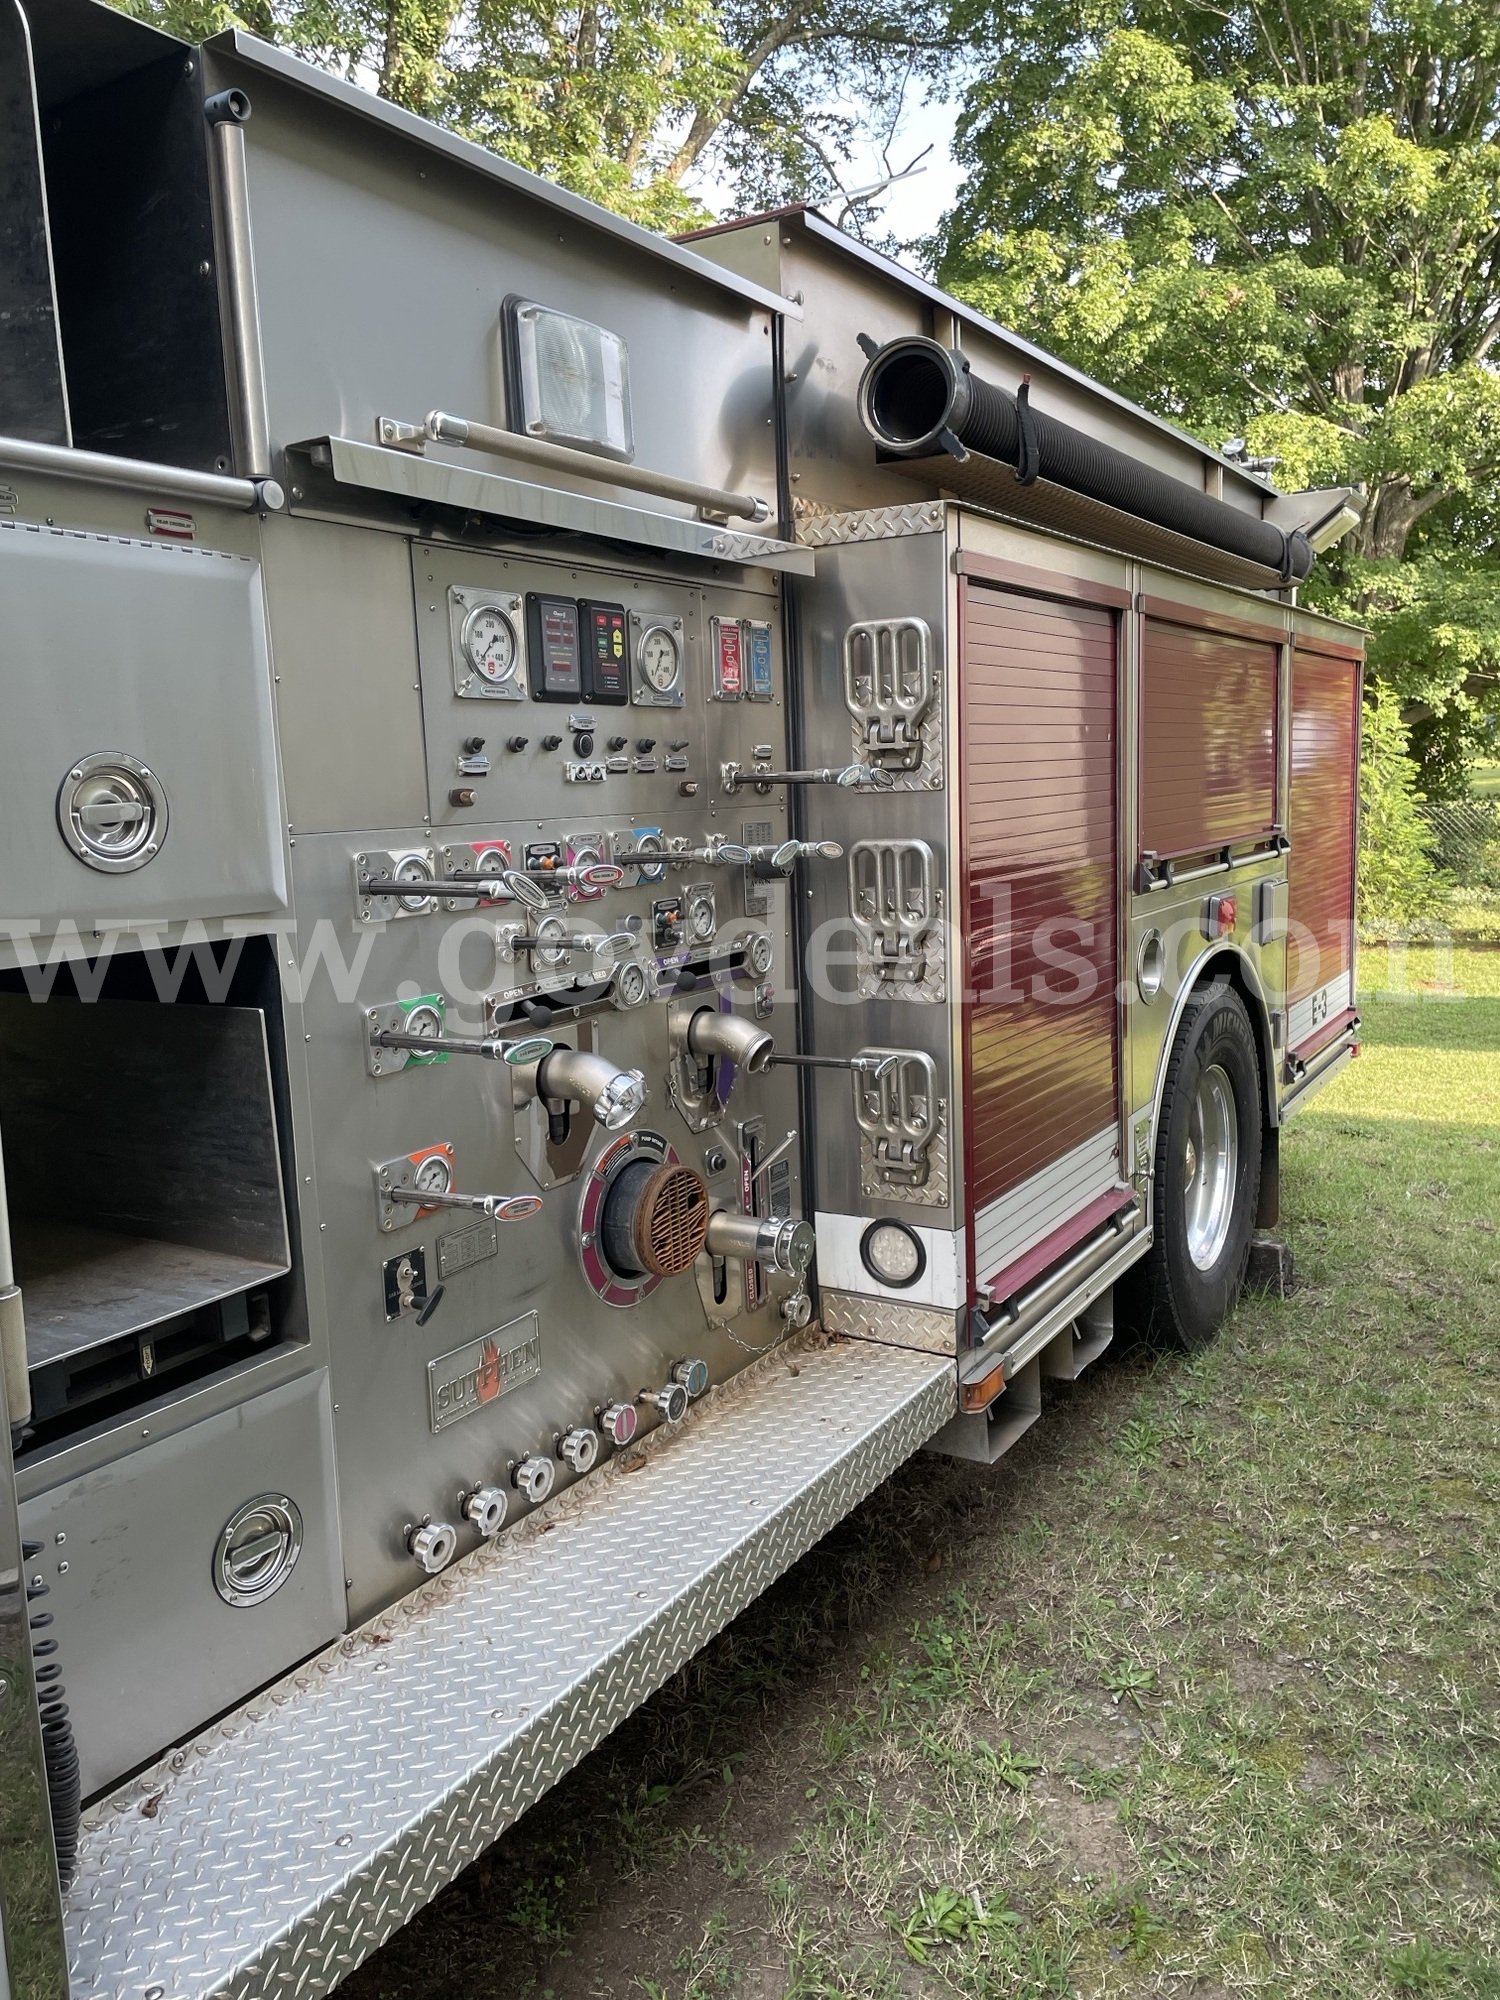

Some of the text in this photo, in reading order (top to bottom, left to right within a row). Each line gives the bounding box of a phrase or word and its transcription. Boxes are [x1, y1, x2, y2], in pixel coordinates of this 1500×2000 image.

[662, 956, 679, 967] OPEN
[503, 988, 524, 1000] OPEN
[1312, 989, 1328, 1026] E-3
[437, 1339, 537, 1411] SUTPHEN
